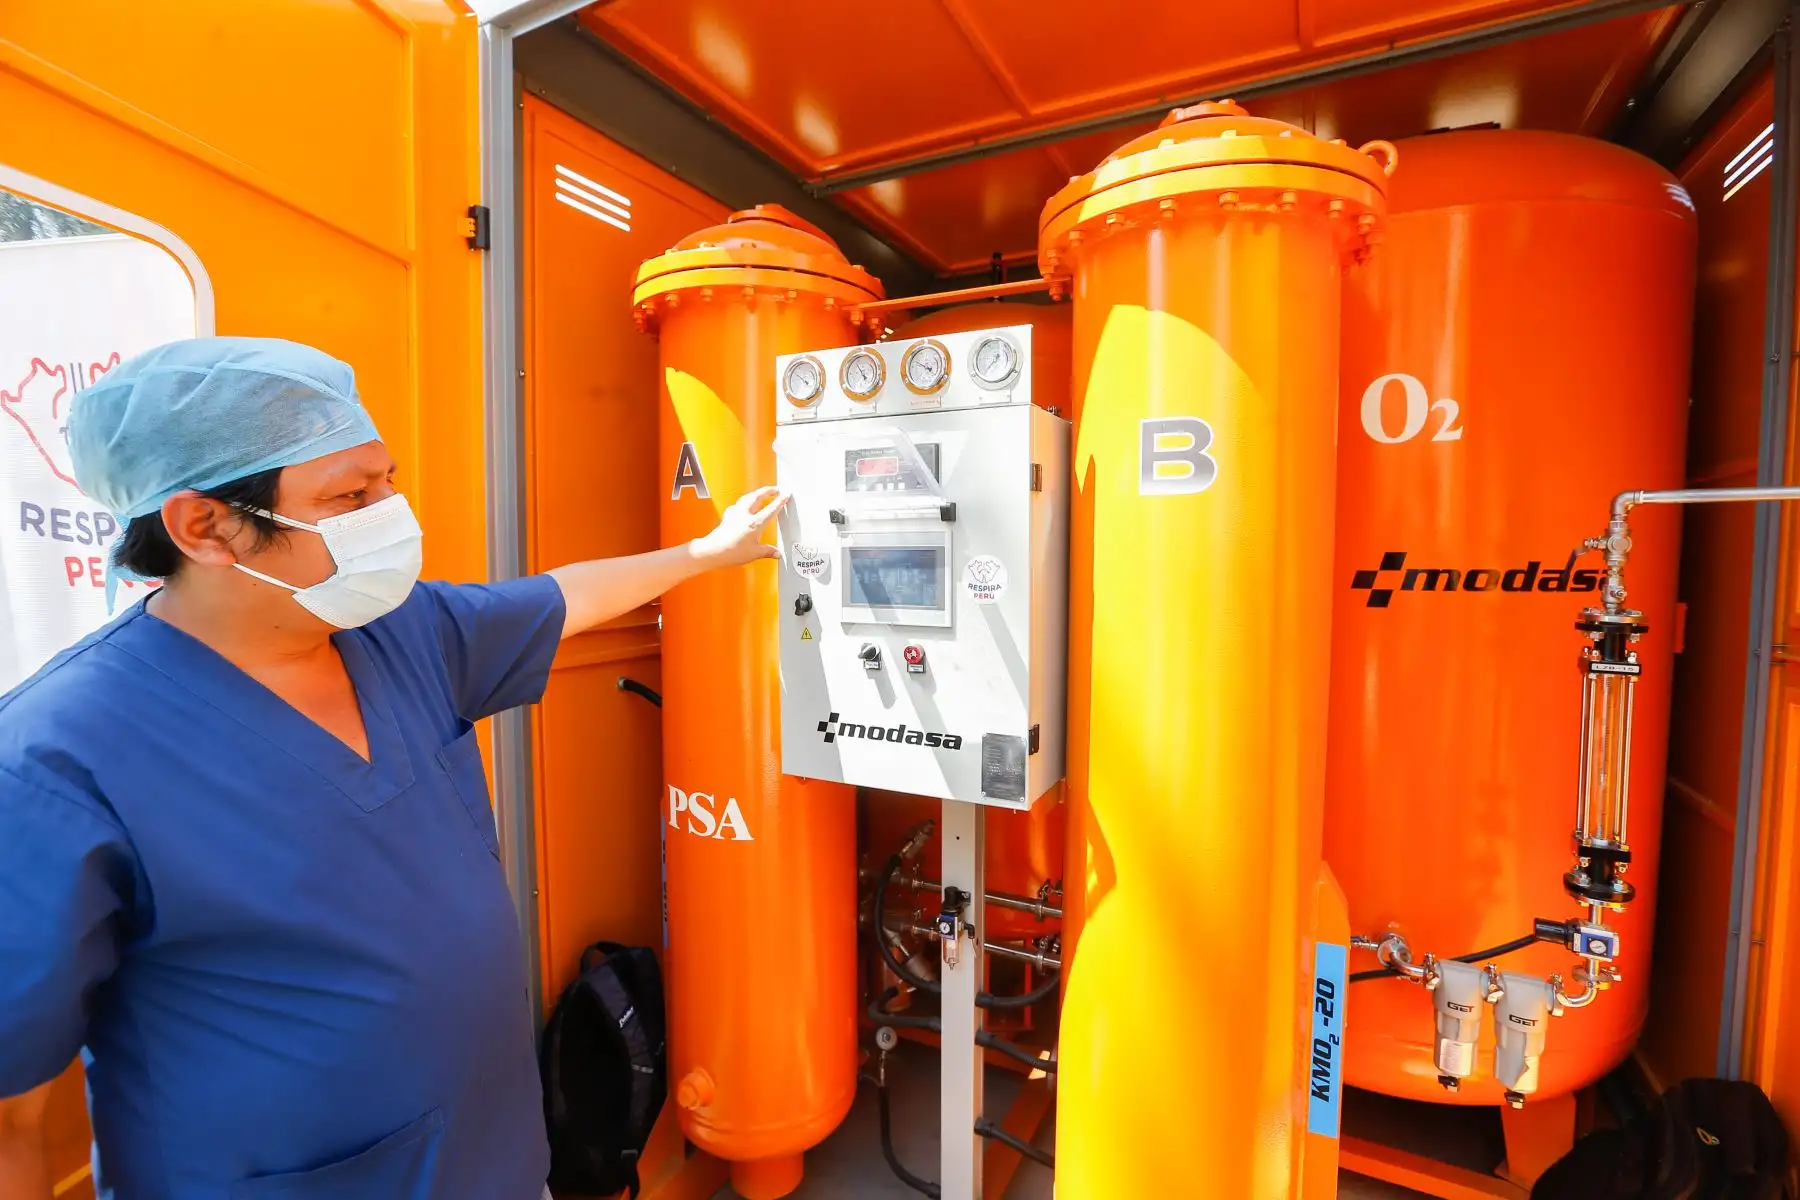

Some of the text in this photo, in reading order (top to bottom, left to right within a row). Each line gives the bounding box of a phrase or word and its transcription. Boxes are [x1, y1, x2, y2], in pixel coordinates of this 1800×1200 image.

[671, 441, 711, 500] A
[1138, 416, 1218, 496] B
[797, 558, 825, 568] RESPIRA
[967, 582, 1002, 592] RESPIRA
[838, 722, 963, 751] modasa
[668, 784, 756, 841] PSA
